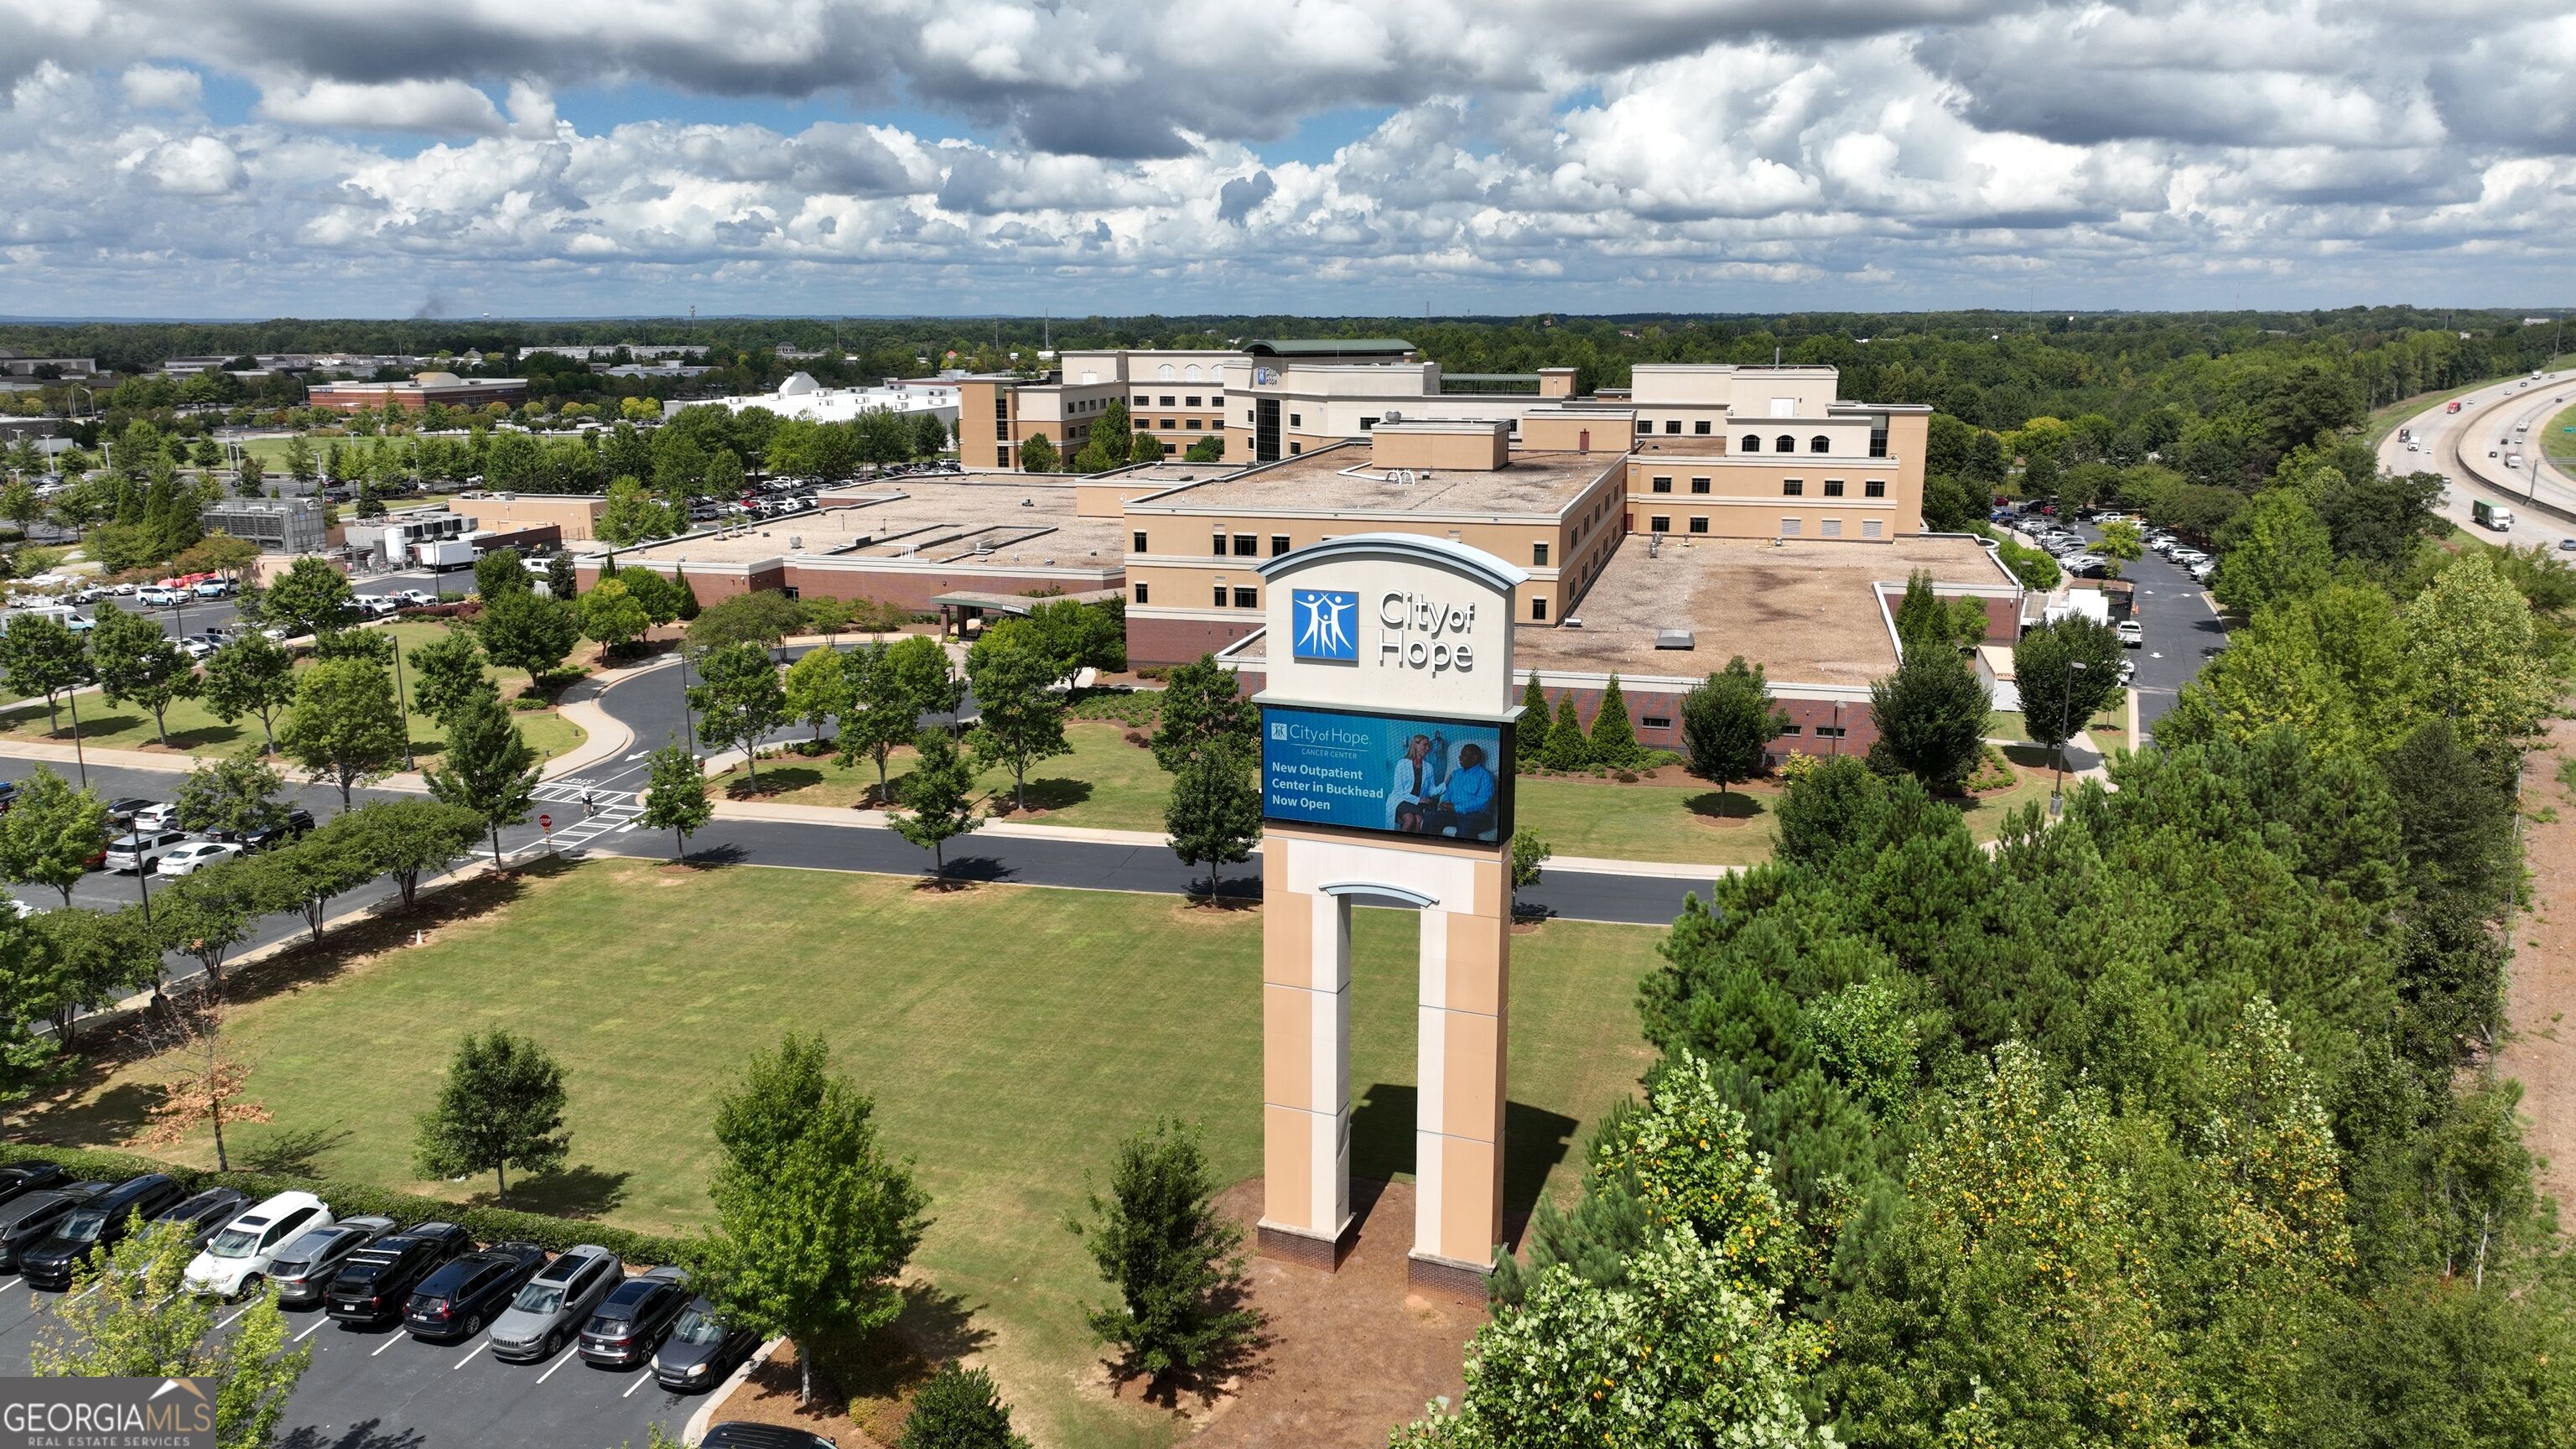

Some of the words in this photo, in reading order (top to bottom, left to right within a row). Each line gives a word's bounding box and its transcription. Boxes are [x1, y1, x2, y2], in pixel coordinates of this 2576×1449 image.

[1379, 590, 1449, 635] City
[1449, 602, 1475, 628] of
[1379, 629, 1473, 673] Hope
[1290, 724, 1318, 743] City
[1318, 730, 1329, 741] of
[1332, 727, 1369, 746] Hope
[1301, 748, 1329, 757] CANCER
[1330, 750, 1358, 759] CENTER
[1272, 761, 1297, 773] New
[1300, 764, 1363, 780] Outpatient
[1272, 778, 1310, 791] Center
[1312, 782, 1323, 793] in
[1326, 783, 1384, 798] Buckhead
[1272, 794, 1298, 807] Now
[1300, 797, 1331, 811] Open
